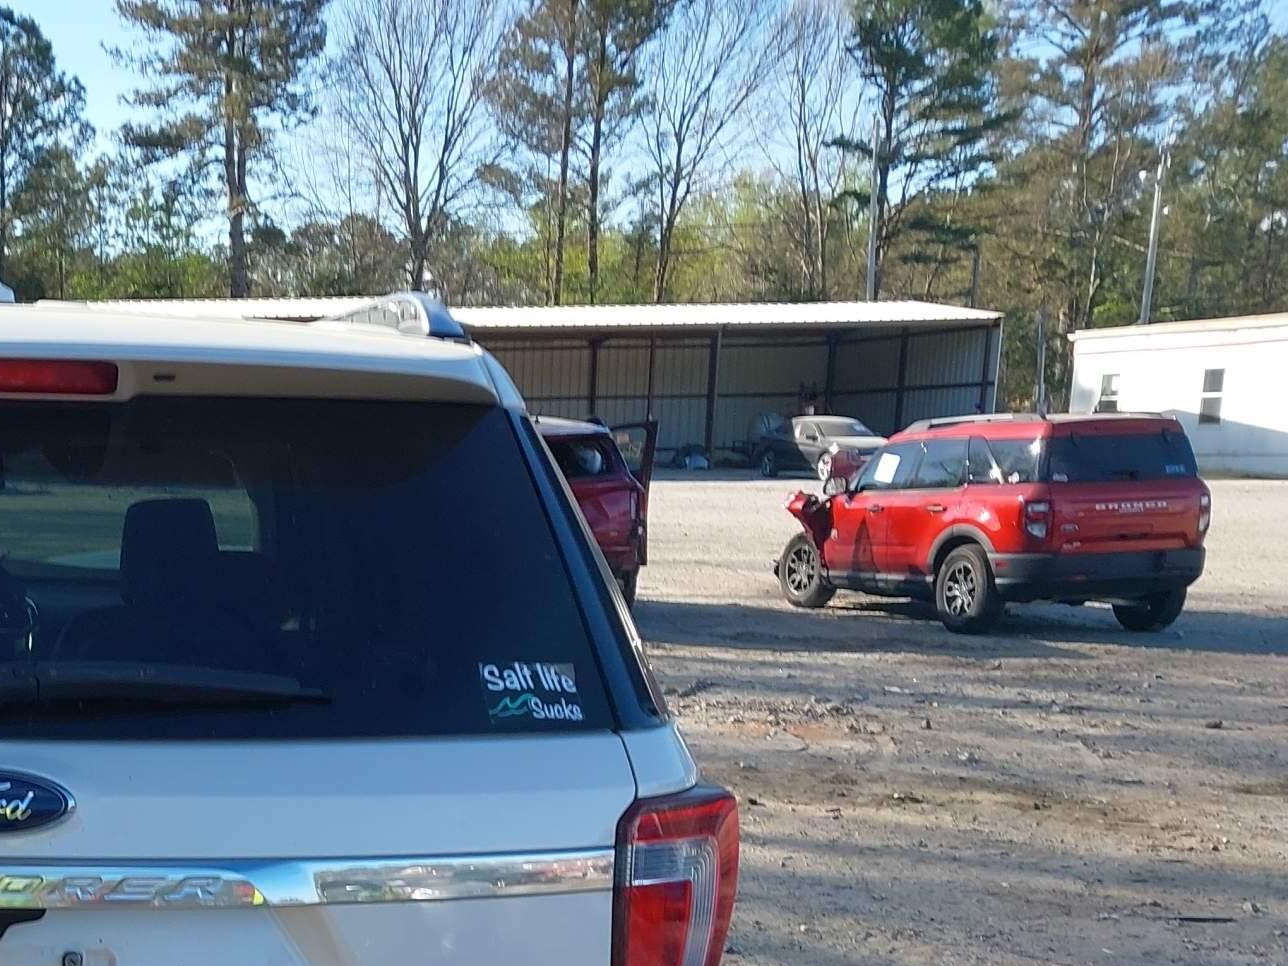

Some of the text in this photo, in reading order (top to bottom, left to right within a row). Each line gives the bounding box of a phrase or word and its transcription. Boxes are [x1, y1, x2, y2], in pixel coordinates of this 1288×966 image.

[483, 661, 577, 693] Salt life
[531, 696, 584, 721] Sucks
